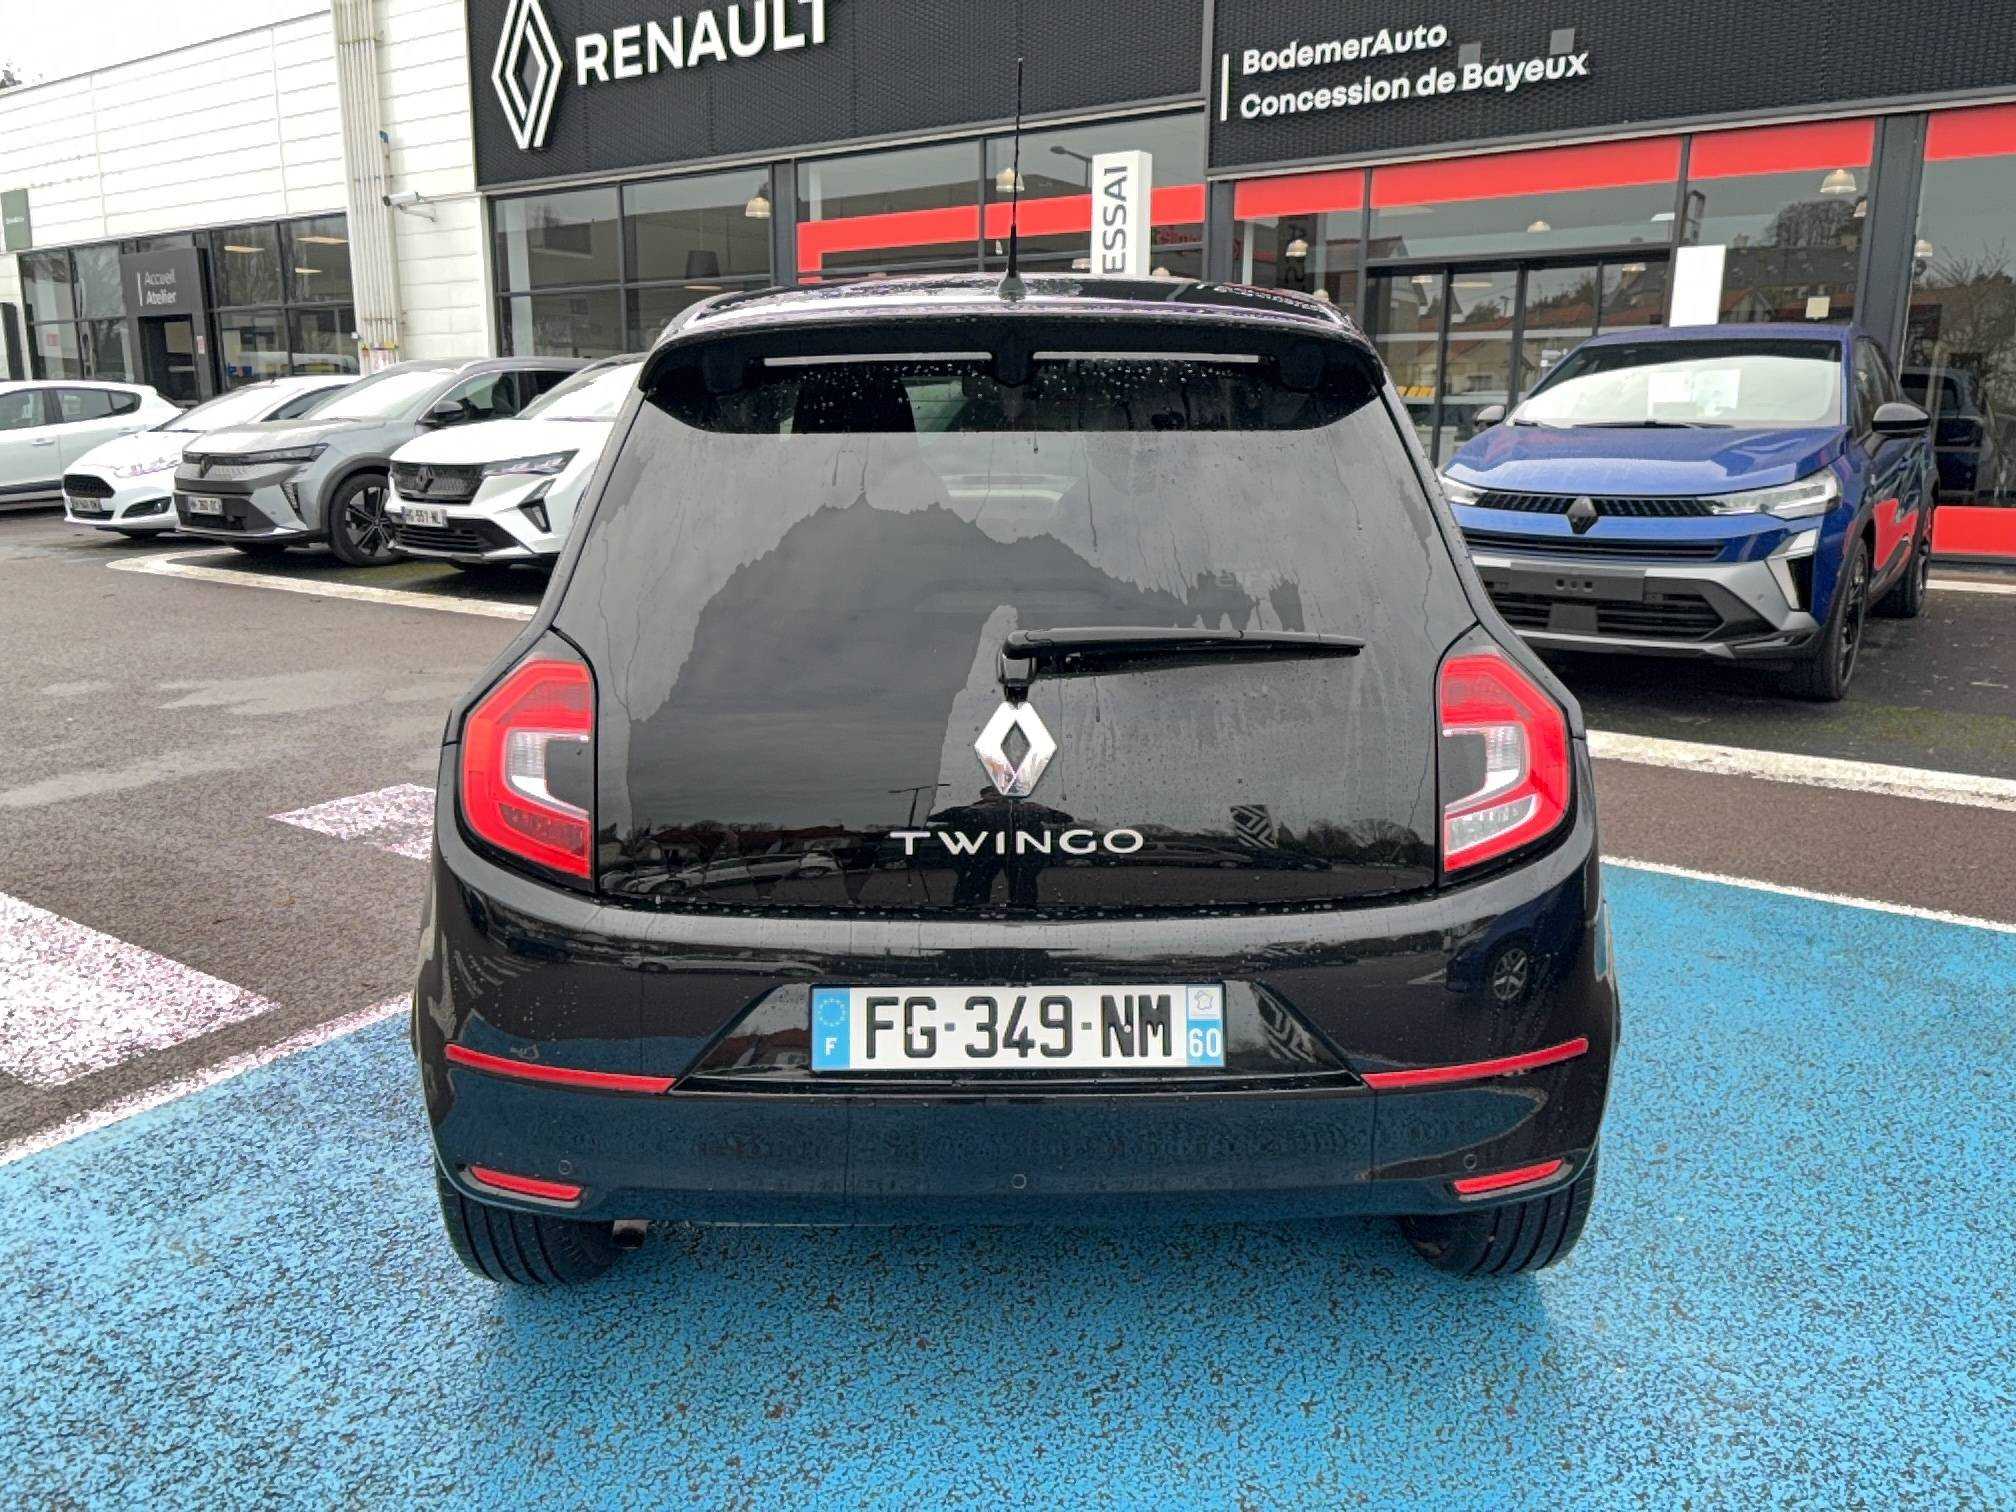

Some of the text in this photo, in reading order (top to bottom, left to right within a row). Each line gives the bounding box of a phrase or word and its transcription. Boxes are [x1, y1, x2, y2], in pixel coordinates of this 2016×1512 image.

[575, 0, 826, 86] RENAULT
[1242, 24, 1448, 75] BodemerAuto
[1240, 51, 1590, 119] Concession de Bayeux
[1102, 166, 1128, 274] ESSAI
[144, 268, 177, 286] Accueil
[146, 288, 177, 305] Atelier
[889, 829, 1144, 856] TWINGO
[824, 1037, 838, 1057] F
[866, 995, 1172, 1059] FG-349-NM
[1188, 1027, 1222, 1058] 60
